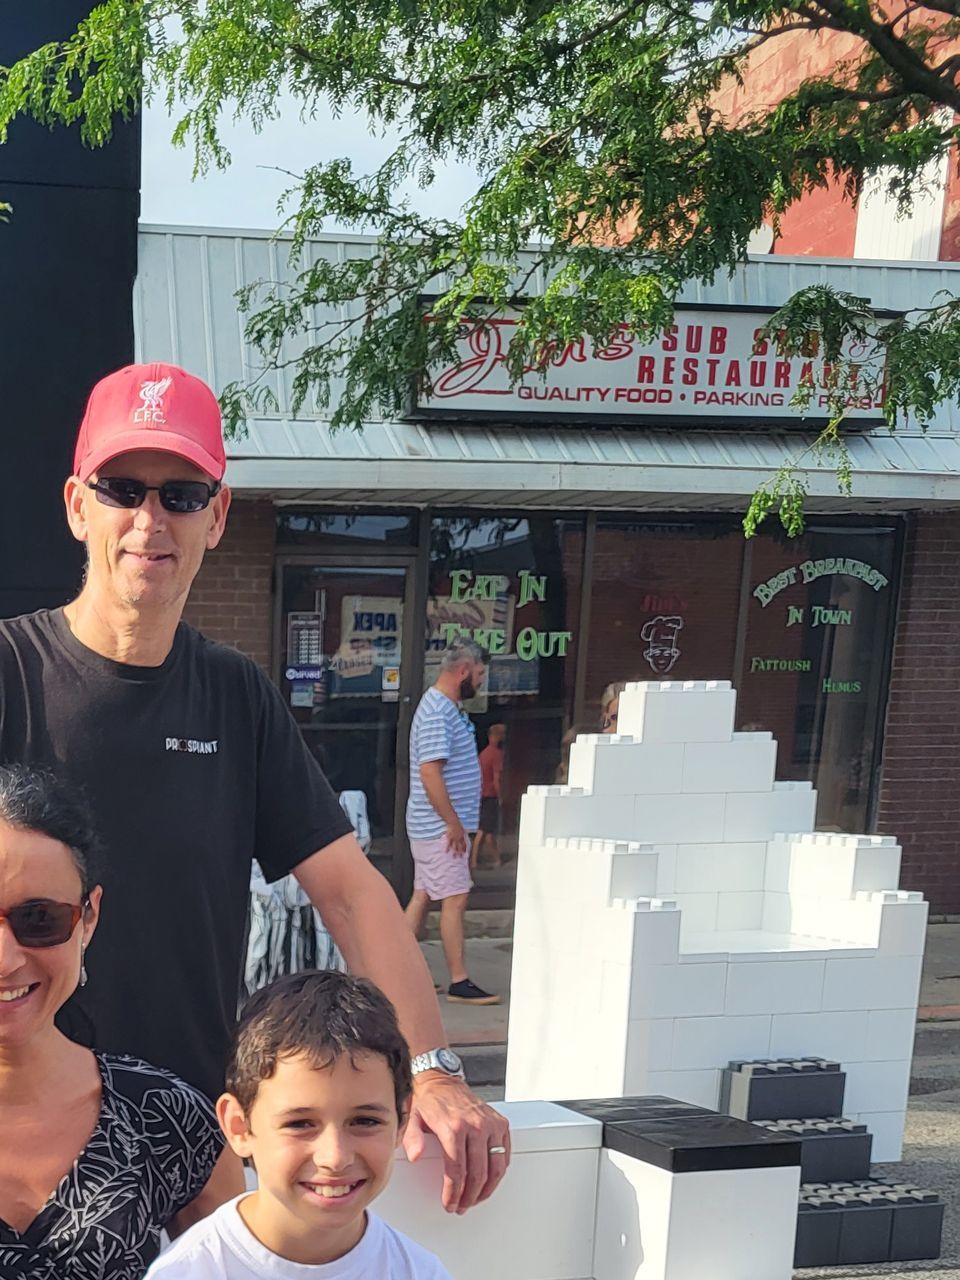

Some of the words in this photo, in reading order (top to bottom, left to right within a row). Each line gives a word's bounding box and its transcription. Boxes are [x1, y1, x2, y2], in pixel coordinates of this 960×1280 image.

[662, 325, 727, 354] SUB
[517, 386, 607, 403] QUALITY
[614, 388, 672, 404] FOOD
[694, 391, 784, 406] PARKING
[449, 569, 510, 604] EAT
[516, 570, 548, 608] IN
[753, 567, 797, 608] BEST
[799, 558, 889, 591] BREAKFAST
[786, 606, 804, 627] IN
[811, 606, 852, 627] TOWN
[516, 627, 572, 661] OUT
[750, 657, 811, 672] FATTOUSH
